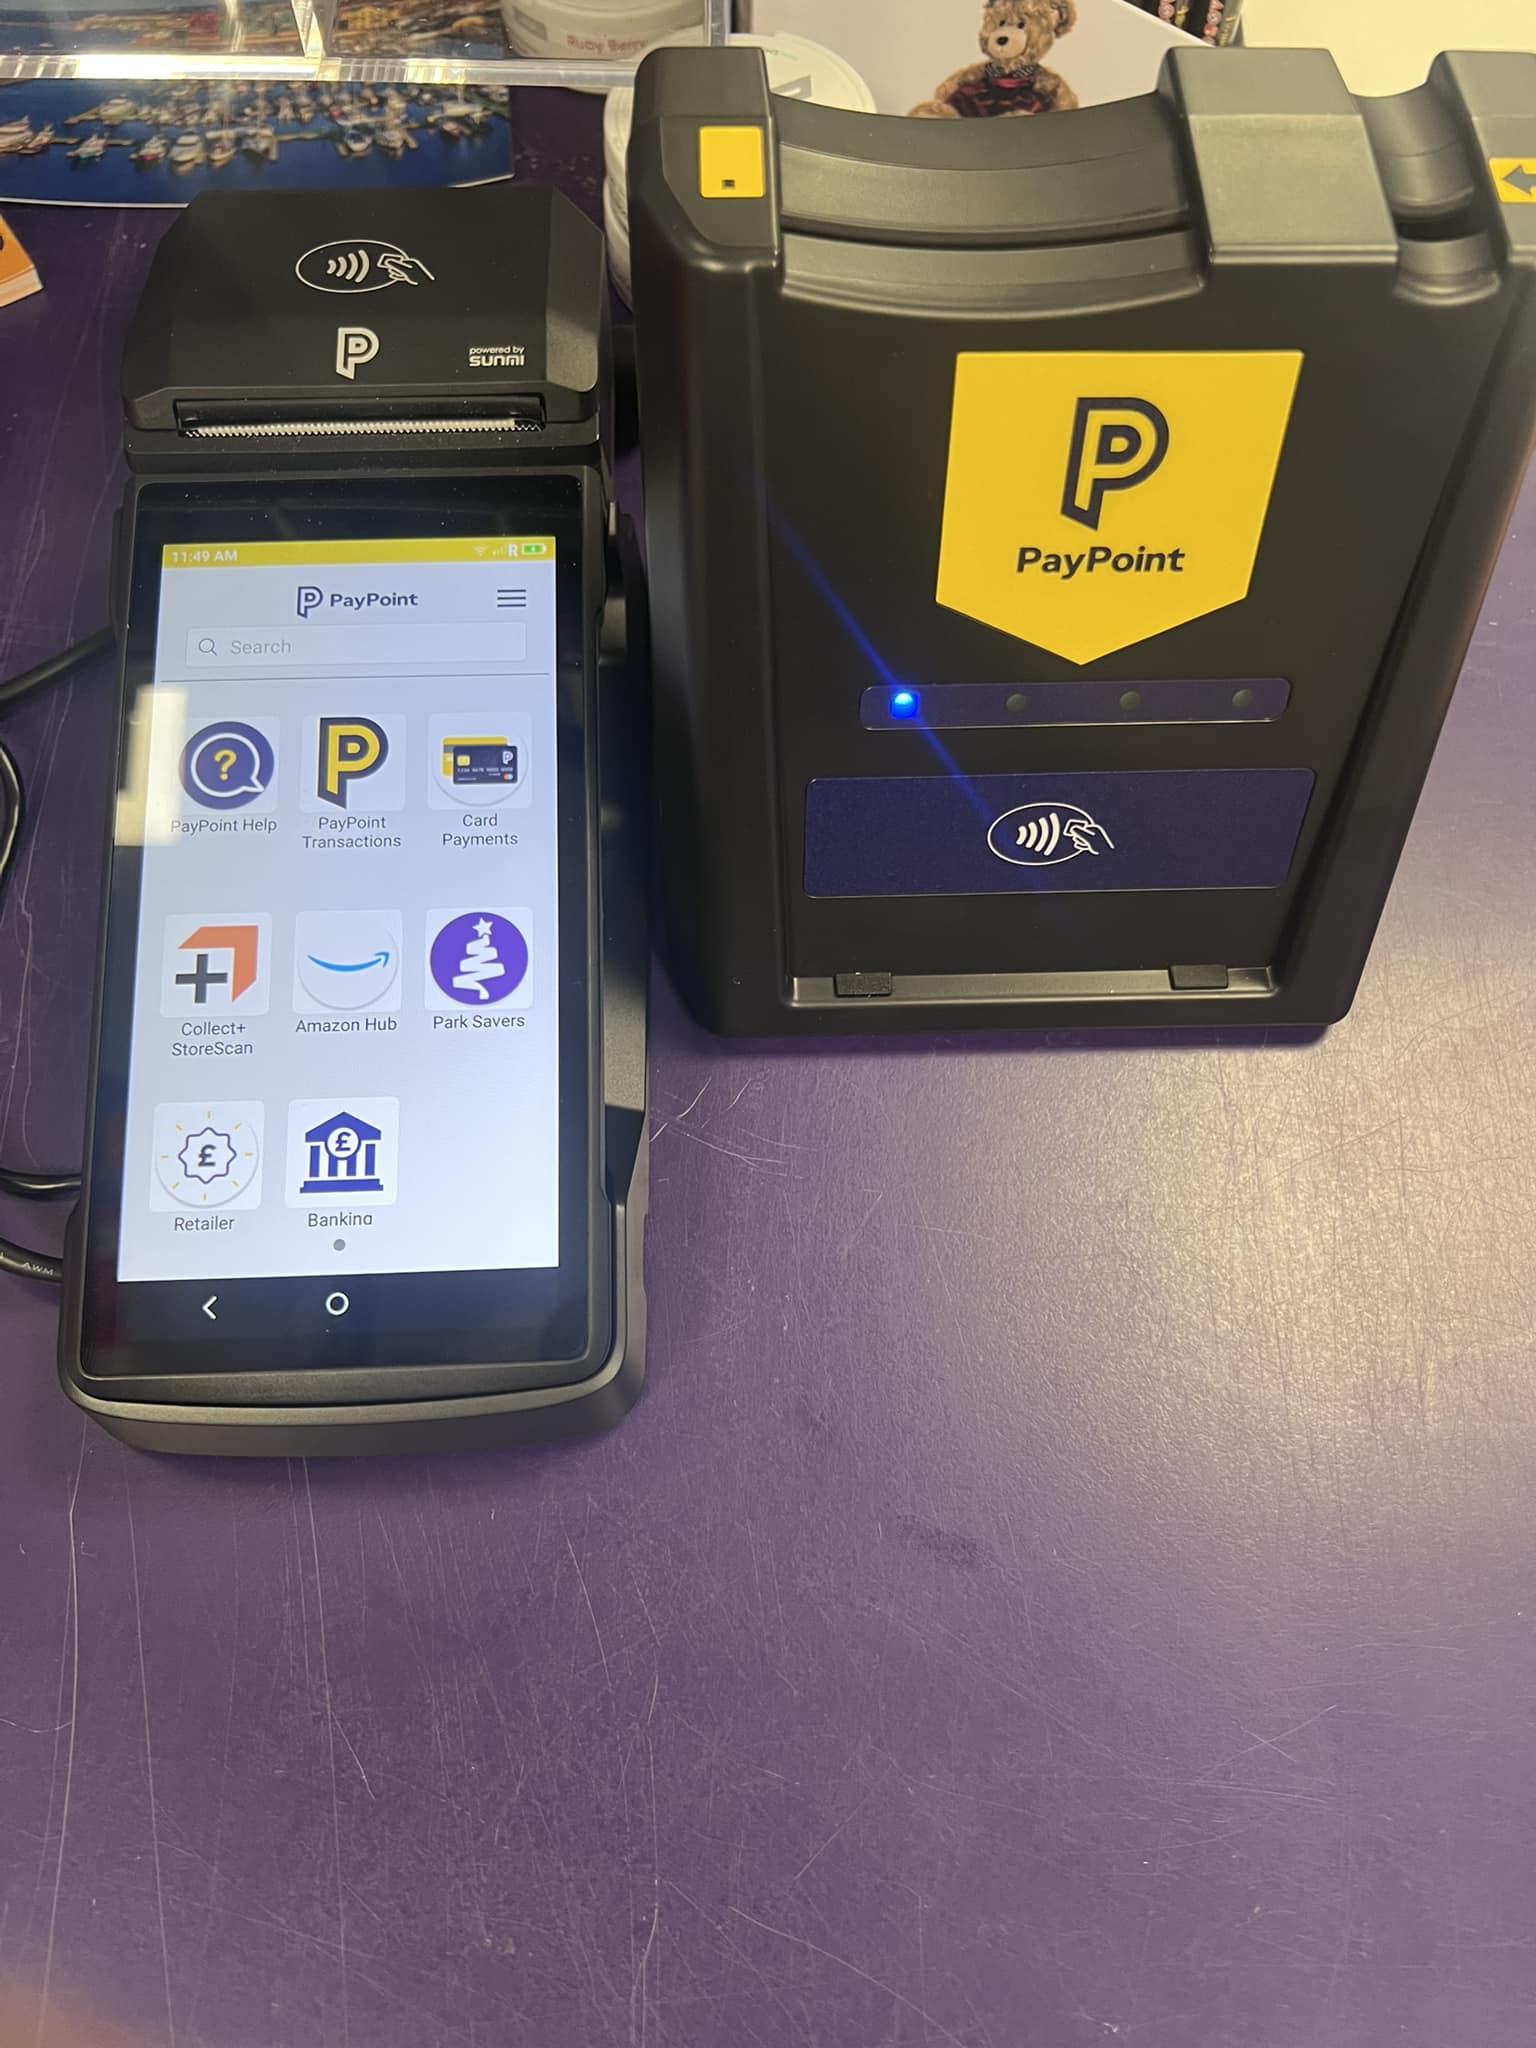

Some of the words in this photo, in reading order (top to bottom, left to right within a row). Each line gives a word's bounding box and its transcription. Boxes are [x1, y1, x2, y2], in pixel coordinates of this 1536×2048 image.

[469, 347, 510, 355] powered
[512, 346, 525, 354] by
[171, 551, 210, 563] 11:49
[213, 550, 238, 562] AM
[1016, 546, 1186, 581] PayPoint
[330, 593, 418, 610] PayPoint
[230, 640, 292, 655] Search
[170, 819, 237, 836] PayPoint
[242, 818, 278, 834] Help
[318, 816, 386, 833] PayPoint
[462, 814, 498, 827] Card
[302, 834, 402, 849] Transactions
[442, 832, 518, 849] Payments
[181, 1022, 246, 1036] Collect+
[296, 1019, 360, 1034] Amazon
[365, 1017, 397, 1032] Hub
[433, 1015, 468, 1030] Park
[472, 1014, 525, 1029] Savers
[172, 1042, 253, 1057] StoreScan
[174, 1216, 235, 1231] Retailer
